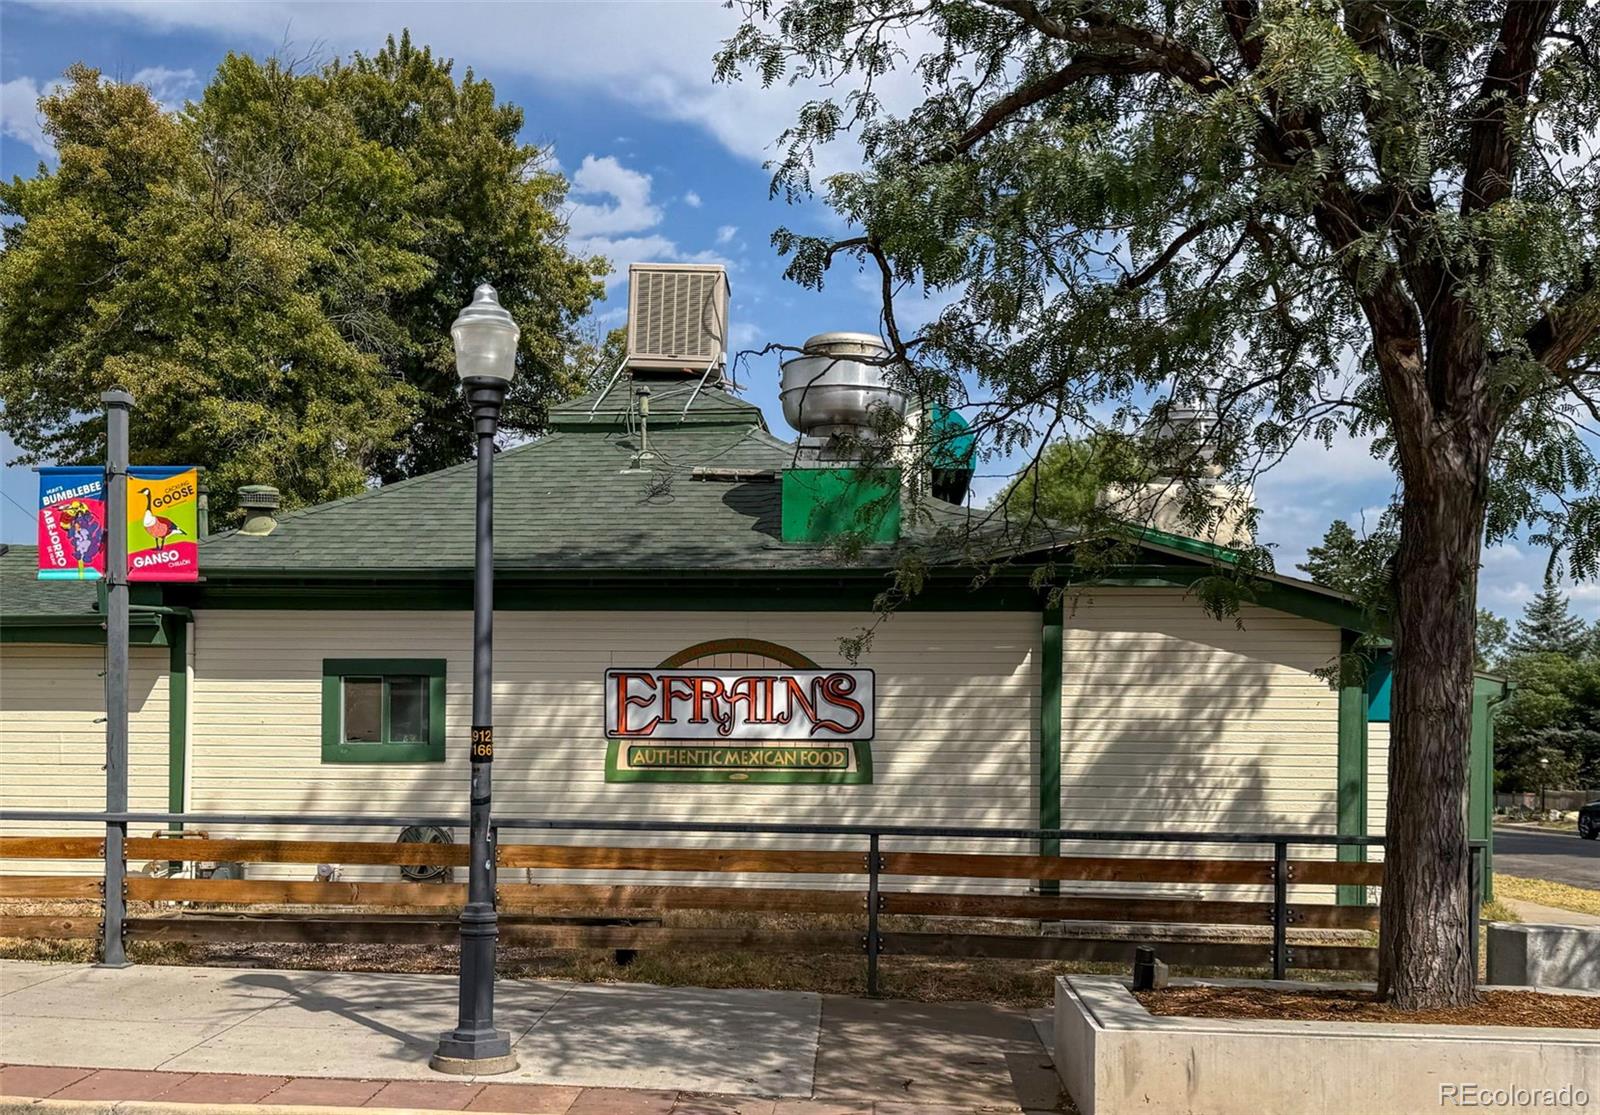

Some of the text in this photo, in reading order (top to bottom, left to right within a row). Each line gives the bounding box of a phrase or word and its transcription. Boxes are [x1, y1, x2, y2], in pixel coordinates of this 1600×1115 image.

[42, 481, 102, 506] BUMBLEBEE
[152, 485, 195, 508] GOOSE
[43, 510, 67, 567] ABEJORRO
[133, 550, 179, 568] GANSO
[472, 730, 492, 742] 912
[473, 744, 492, 756] 166
[633, 750, 844, 766] AUTHENTIC MEXICAN FOOD
